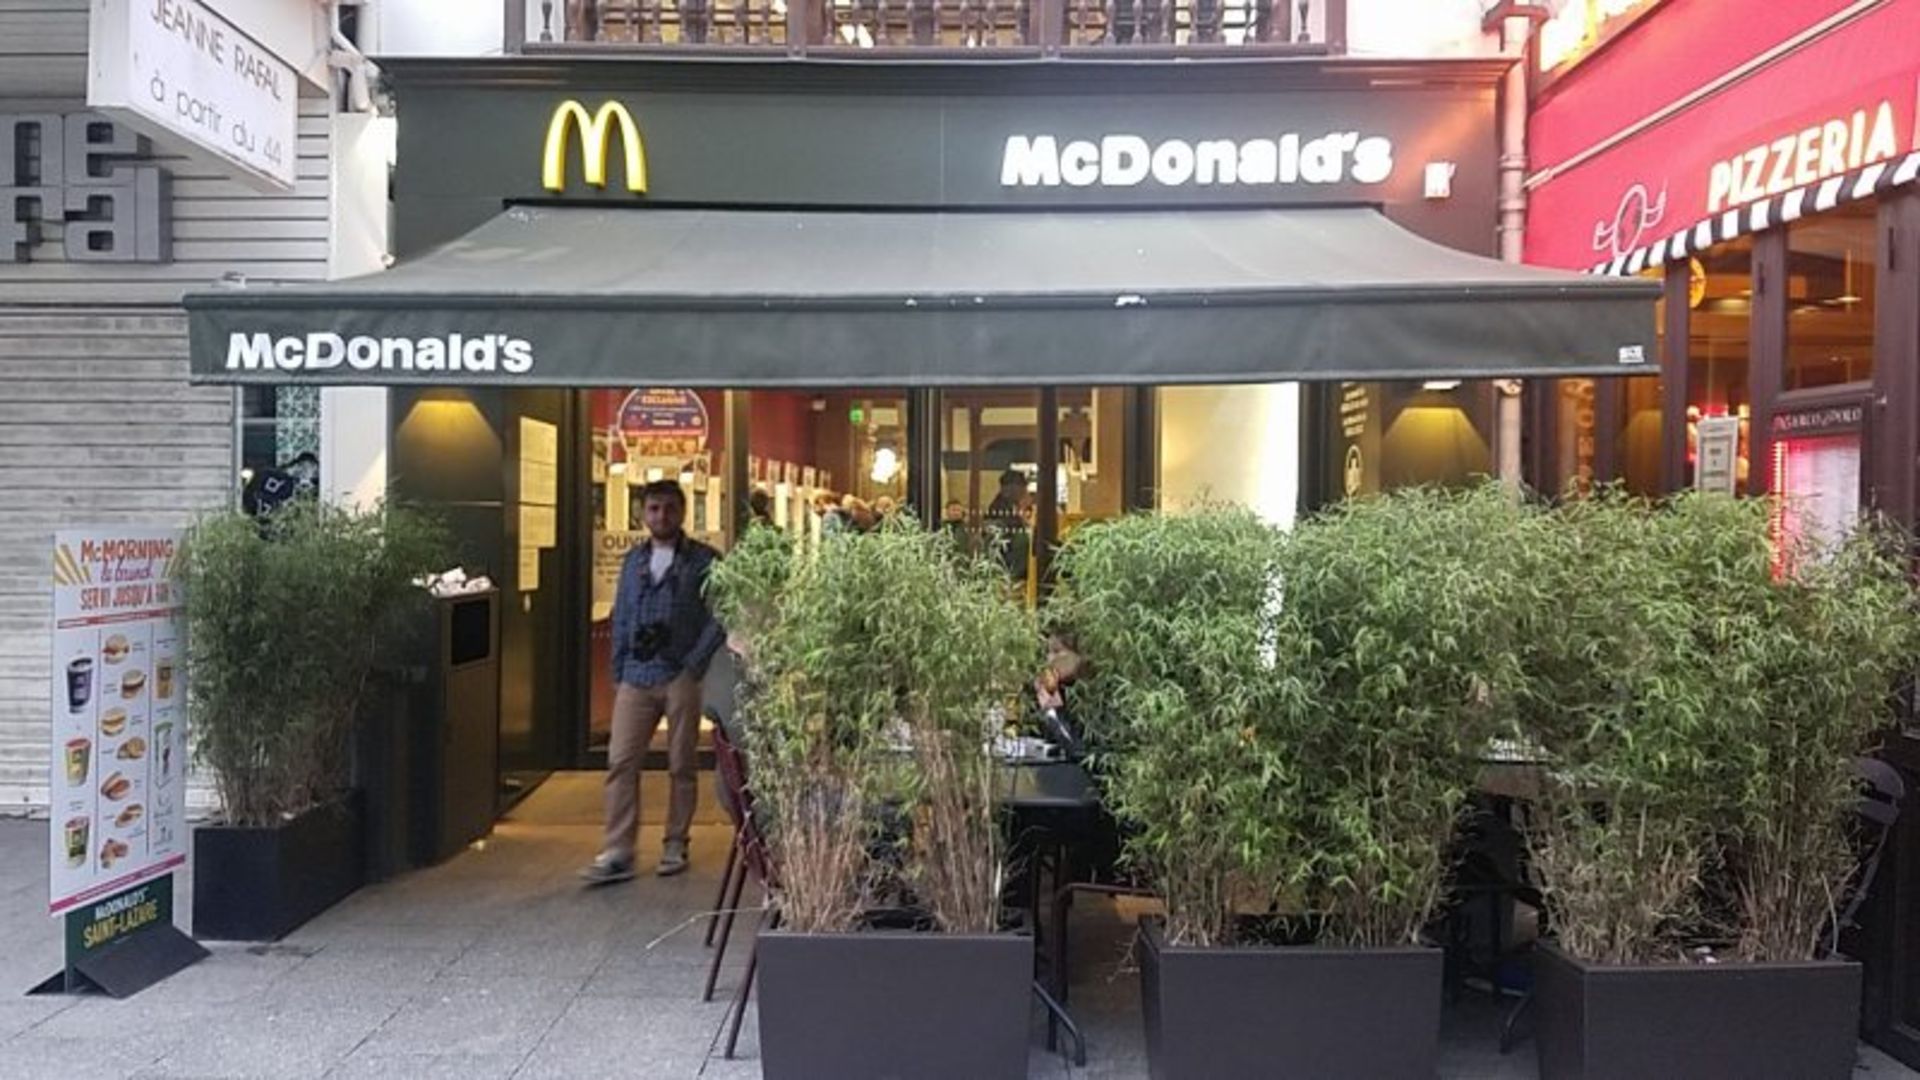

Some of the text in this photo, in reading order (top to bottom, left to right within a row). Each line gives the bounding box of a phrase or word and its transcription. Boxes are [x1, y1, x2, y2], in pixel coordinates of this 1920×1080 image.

[176, 90, 222, 134] partir
[232, 119, 256, 153] du
[1000, 131, 1392, 186] McDonald's
[1706, 100, 1897, 214] PIZZERIA
[226, 332, 534, 373] McDonald's
